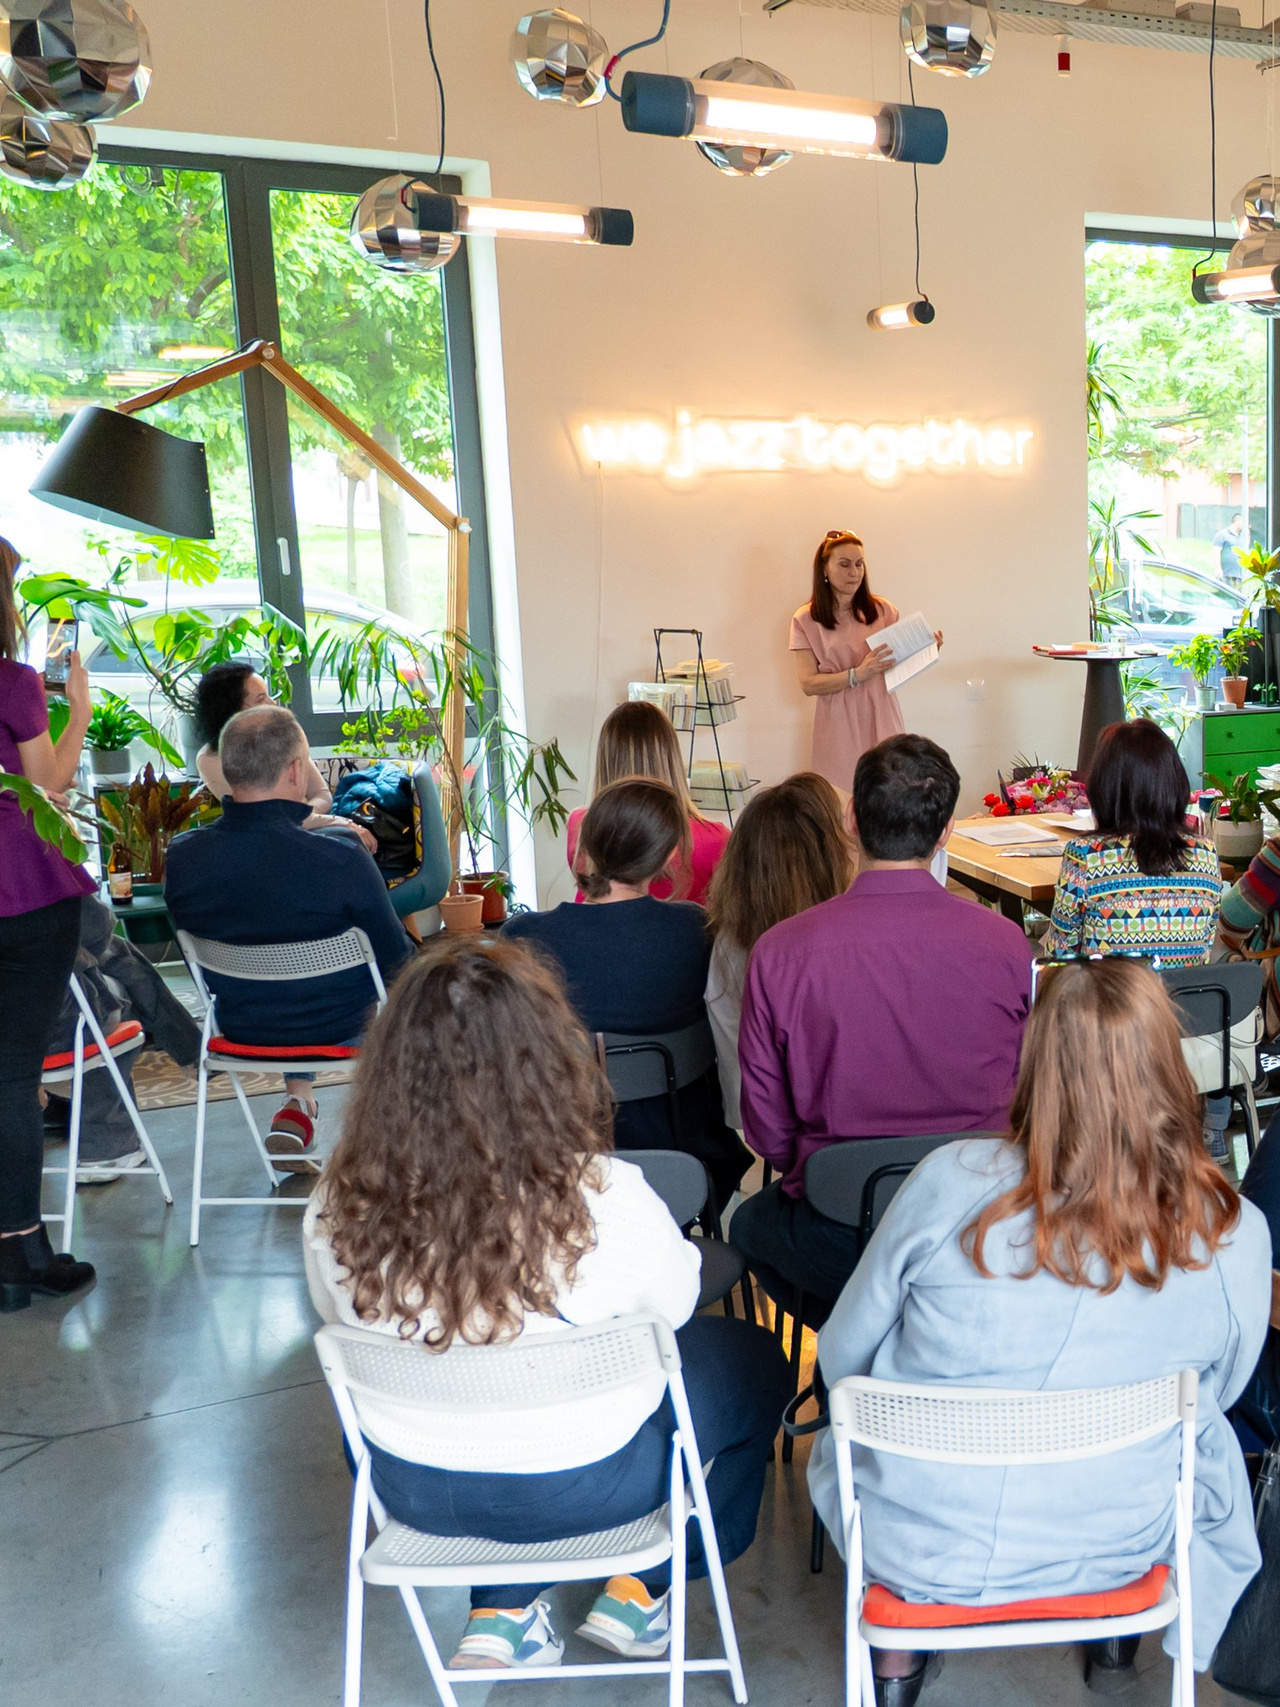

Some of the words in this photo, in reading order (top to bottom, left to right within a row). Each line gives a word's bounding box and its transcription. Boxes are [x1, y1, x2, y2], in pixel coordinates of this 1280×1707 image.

[582, 422, 669, 464] we
[666, 410, 786, 478] jazz
[795, 416, 1034, 480] together
